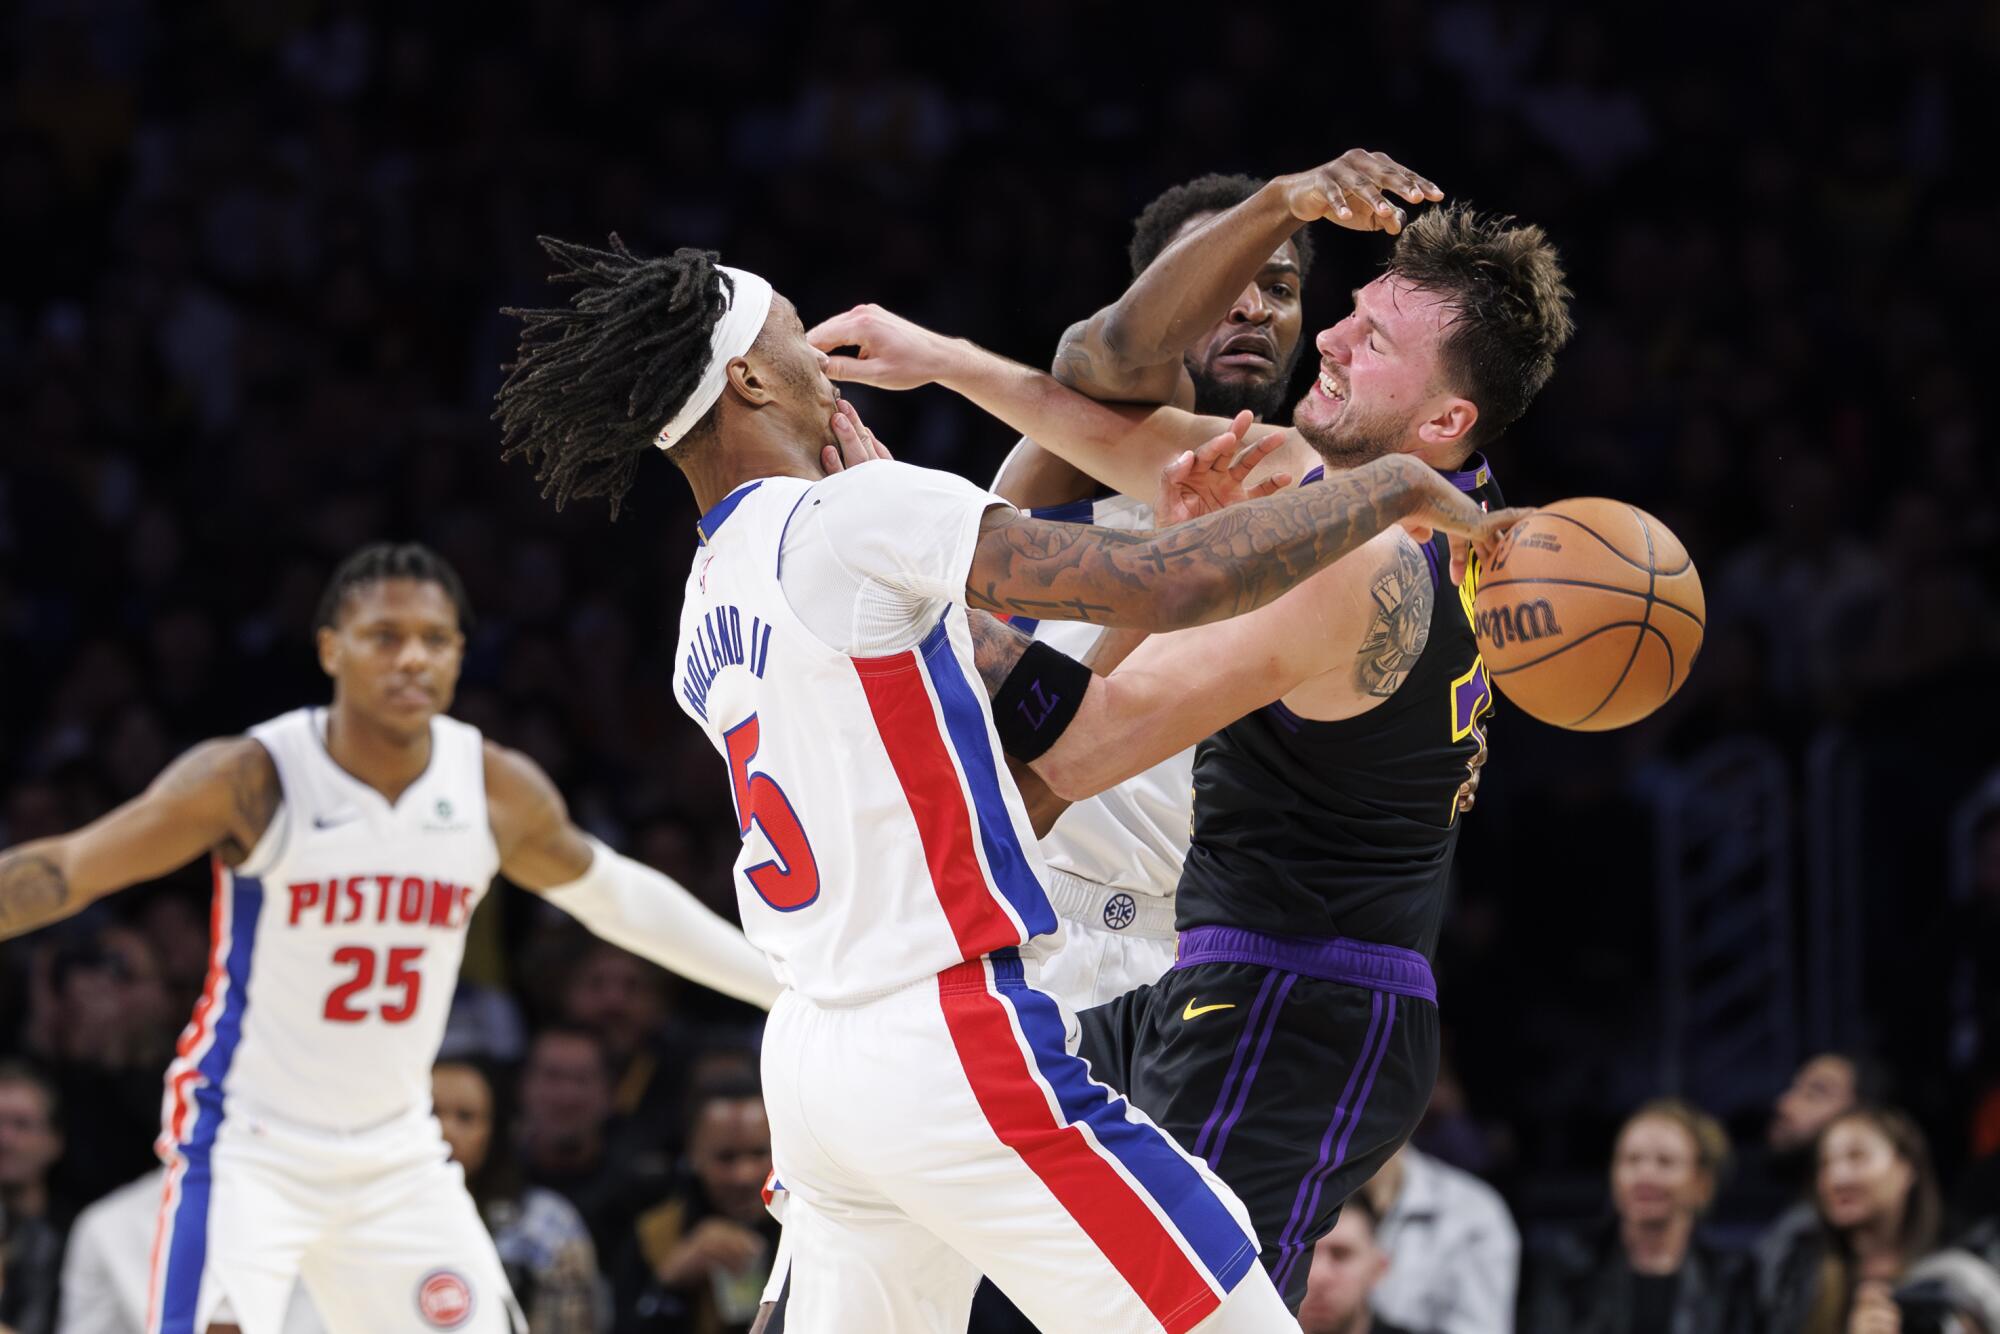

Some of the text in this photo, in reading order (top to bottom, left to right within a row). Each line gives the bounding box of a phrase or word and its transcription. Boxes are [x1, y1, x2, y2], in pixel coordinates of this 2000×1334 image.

[683, 605, 772, 724] HOLLAND II
[723, 710, 820, 912] 5
[323, 945, 426, 1023] 25
